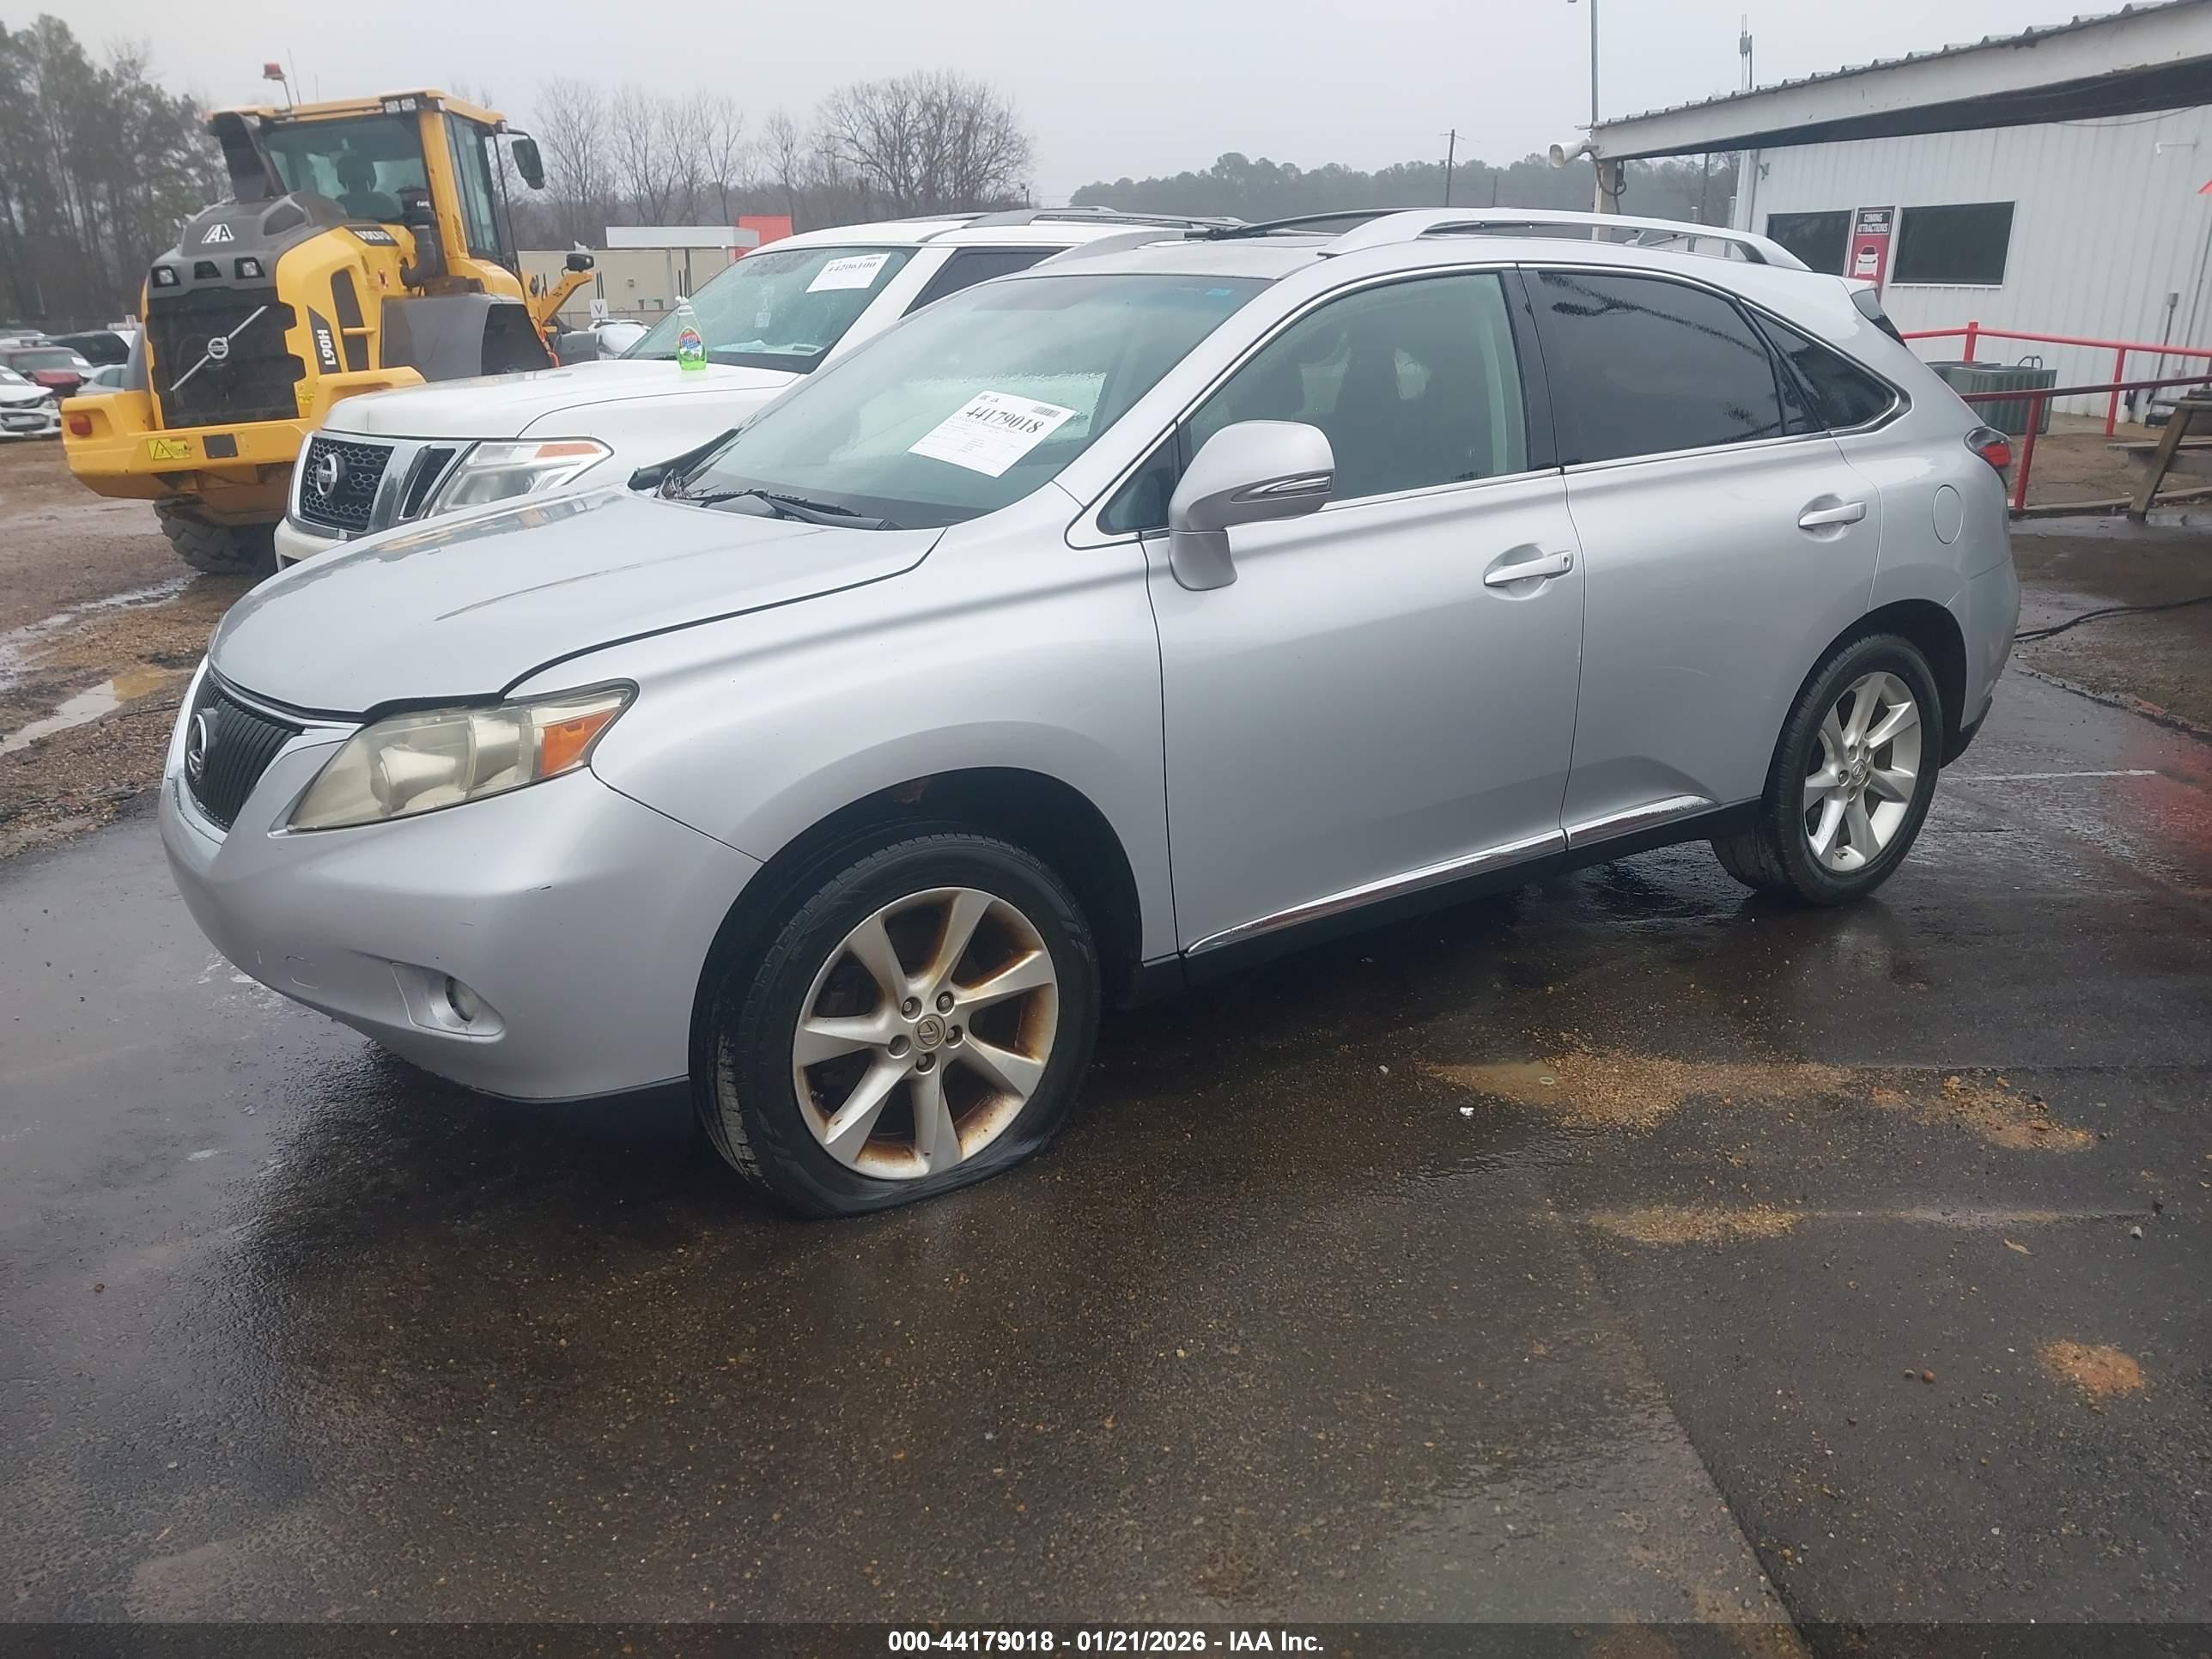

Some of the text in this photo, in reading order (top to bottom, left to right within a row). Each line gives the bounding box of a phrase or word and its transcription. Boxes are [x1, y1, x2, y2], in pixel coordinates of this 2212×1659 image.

[1863, 213, 1883, 222] COMING
[1856, 223, 1889, 233] ATTRACTIONS
[353, 230, 392, 240] VOLVO
[594, 304, 603, 314] V
[316, 329, 337, 365] L90H
[966, 405, 1045, 434] 44179018
